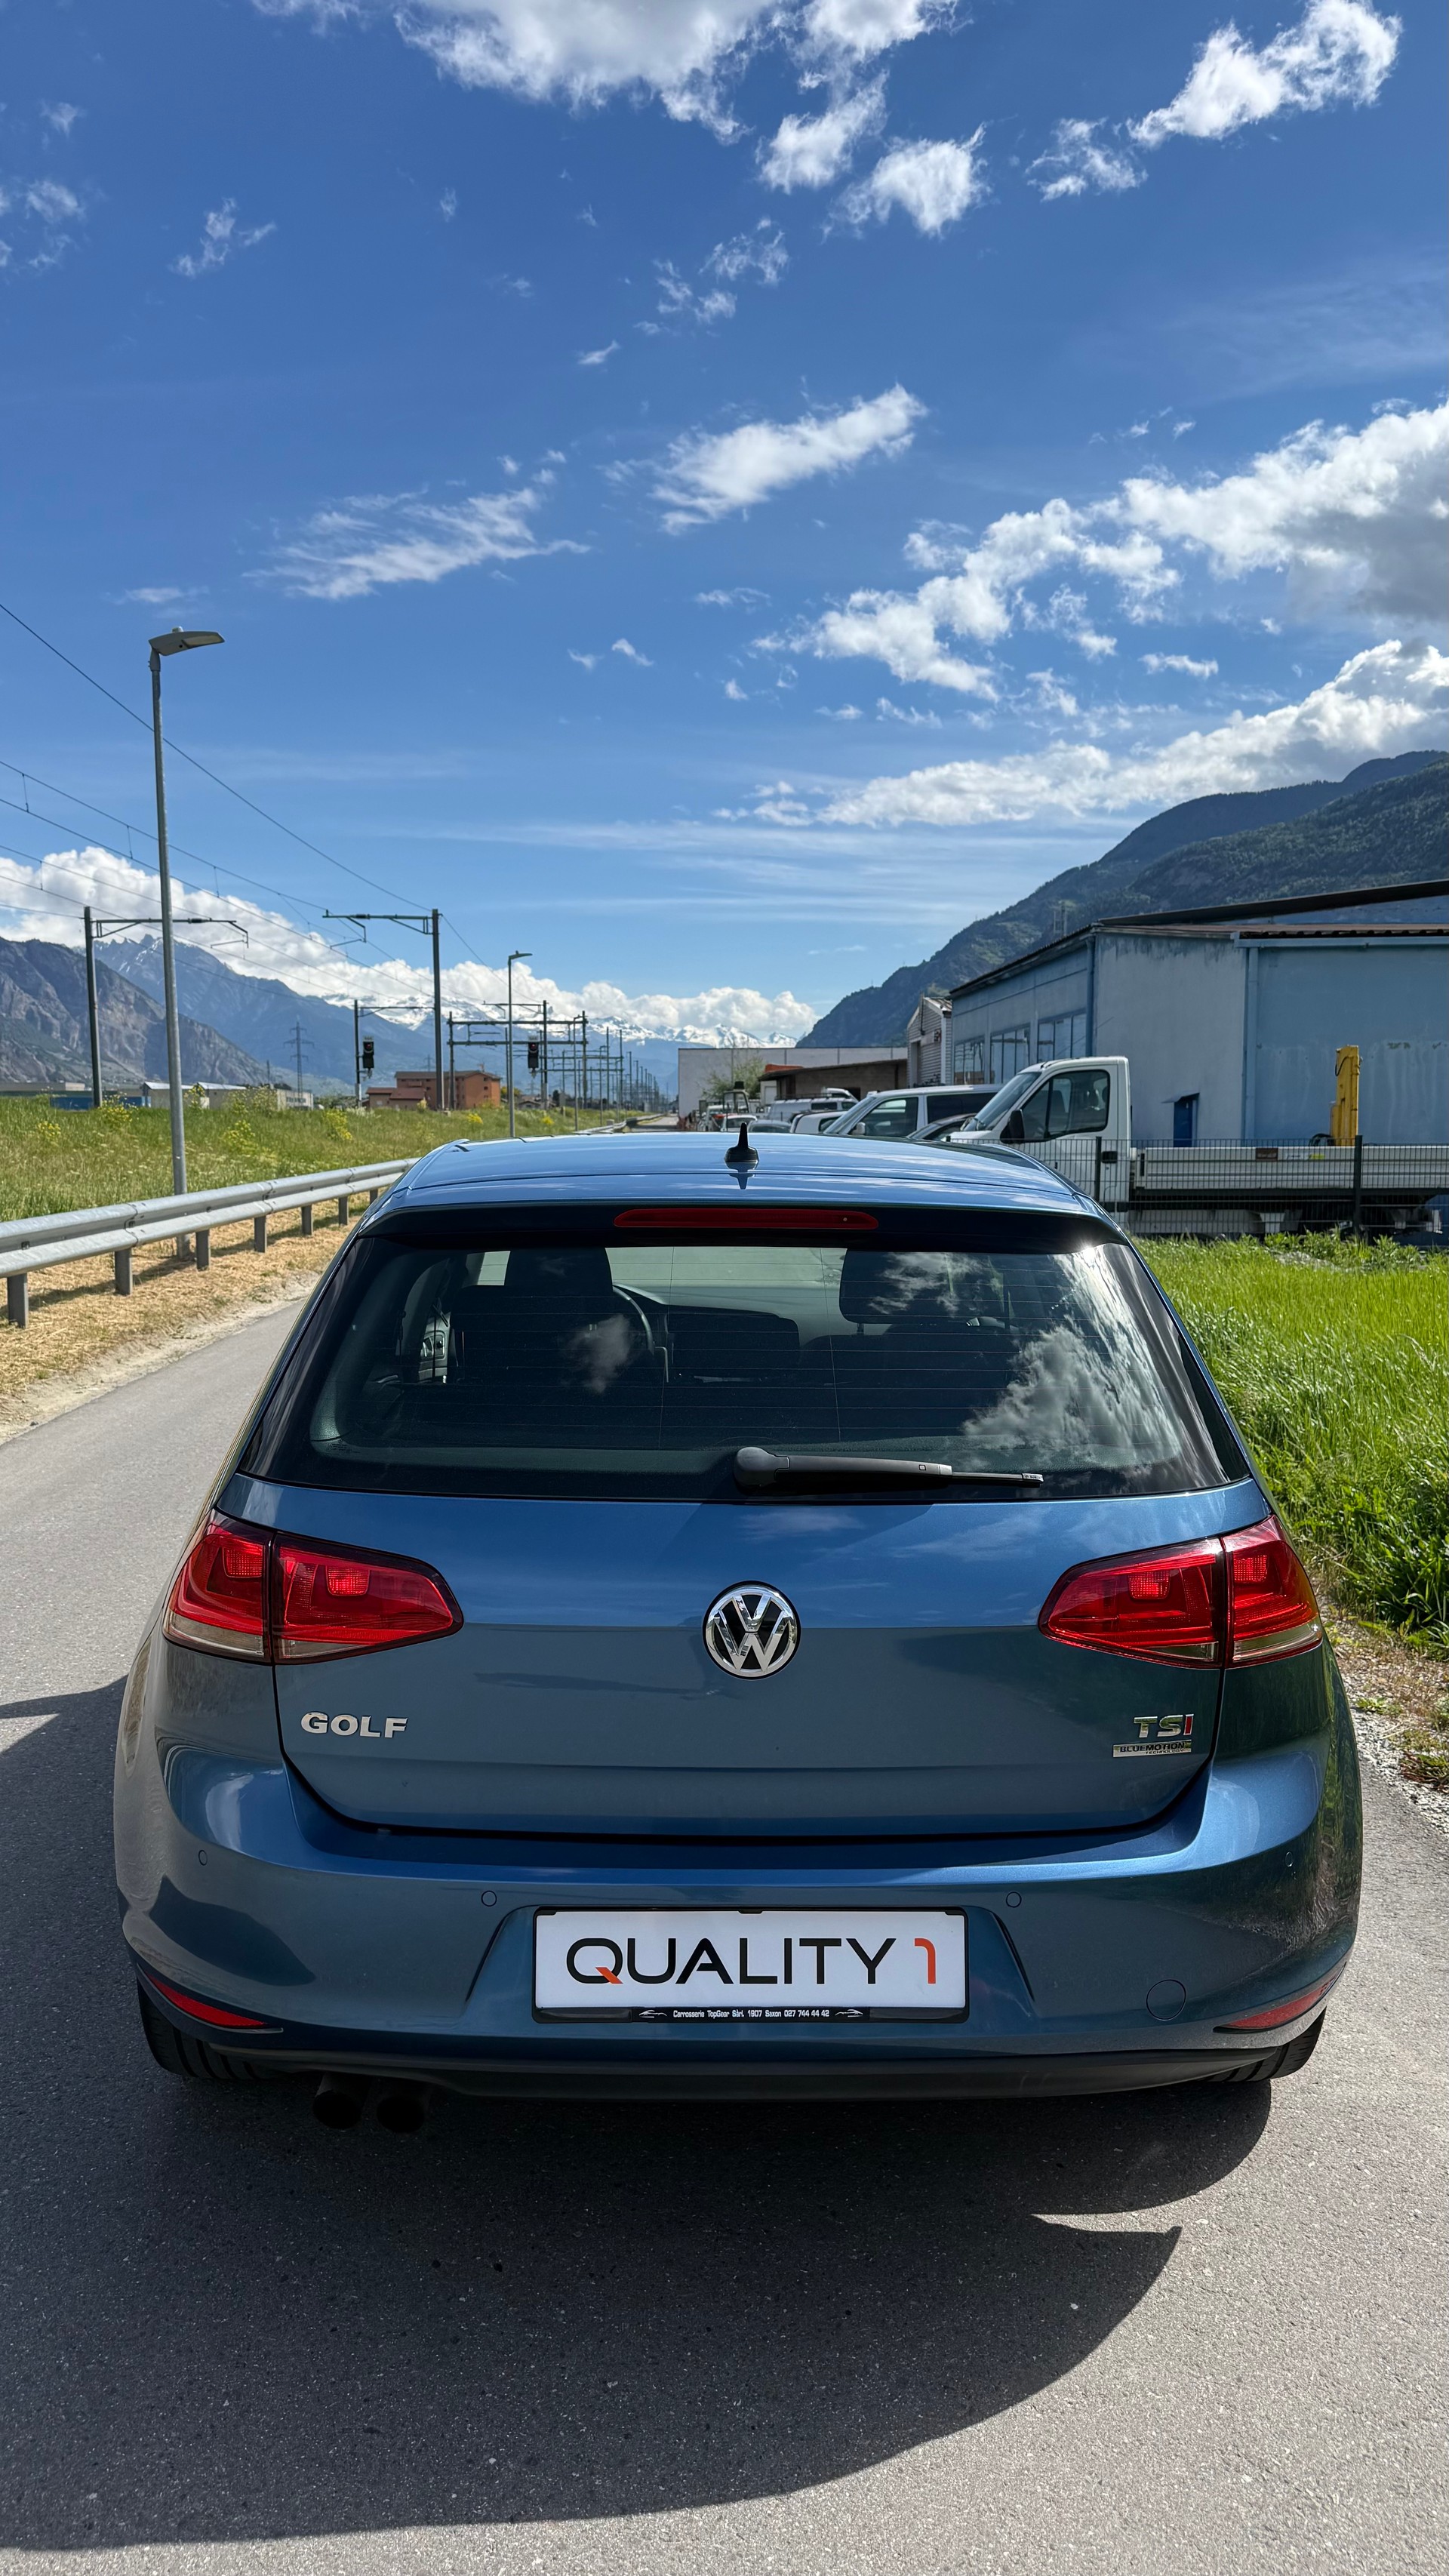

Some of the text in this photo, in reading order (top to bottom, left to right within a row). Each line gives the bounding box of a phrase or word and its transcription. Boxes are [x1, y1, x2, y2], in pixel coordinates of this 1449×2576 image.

[708, 1589, 794, 1673] VW
[300, 1711, 408, 1738] GOLF
[1134, 1713, 1194, 1737] TSI
[566, 1937, 897, 1985] QUALITY
[672, 2009, 705, 2017] Carrosserie
[706, 2009, 730, 2019] TopGear
[747, 2009, 762, 2017] 1907
[764, 2009, 782, 2017] Saxon
[783, 2009, 796, 2017] 027
[798, 2009, 810, 2017] 744
[811, 2009, 820, 2017] 44
[820, 2009, 829, 2017] 42
